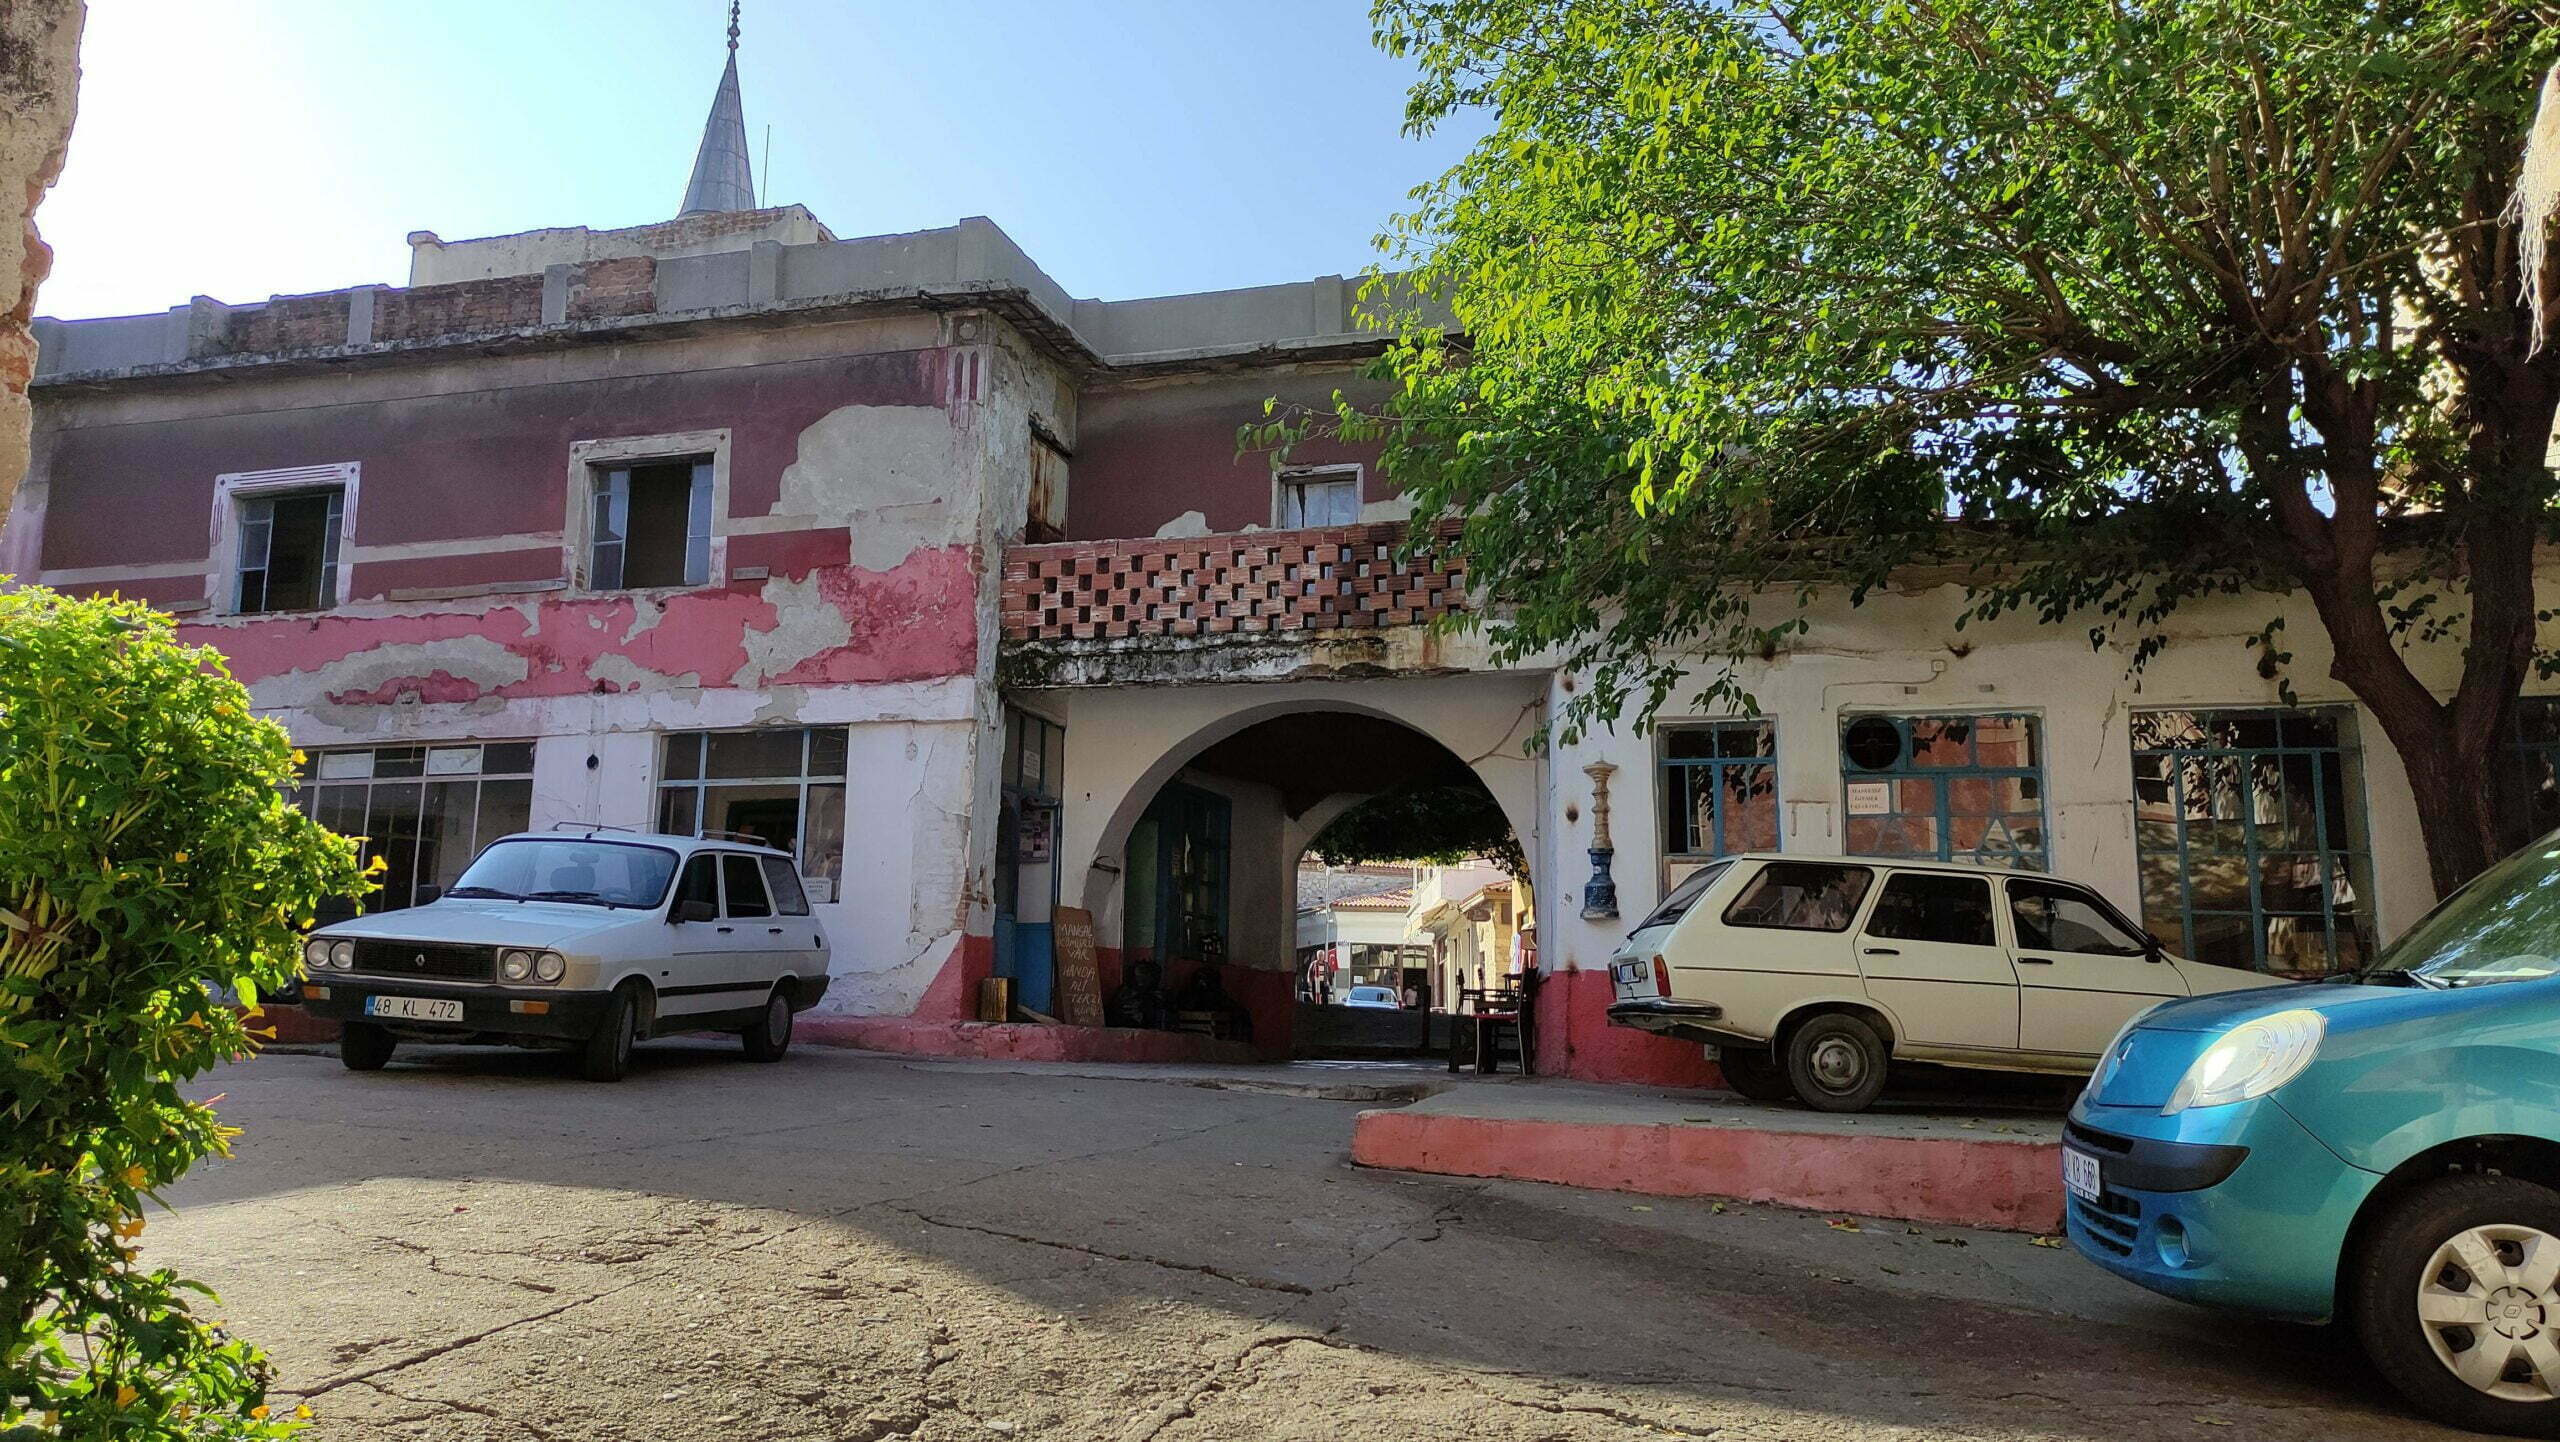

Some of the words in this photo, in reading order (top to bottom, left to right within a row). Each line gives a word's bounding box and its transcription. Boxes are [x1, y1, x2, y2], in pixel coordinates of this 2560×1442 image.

[374, 998, 392, 1014] 48
[402, 999, 418, 1016] KL
[428, 1001, 456, 1018] 472
